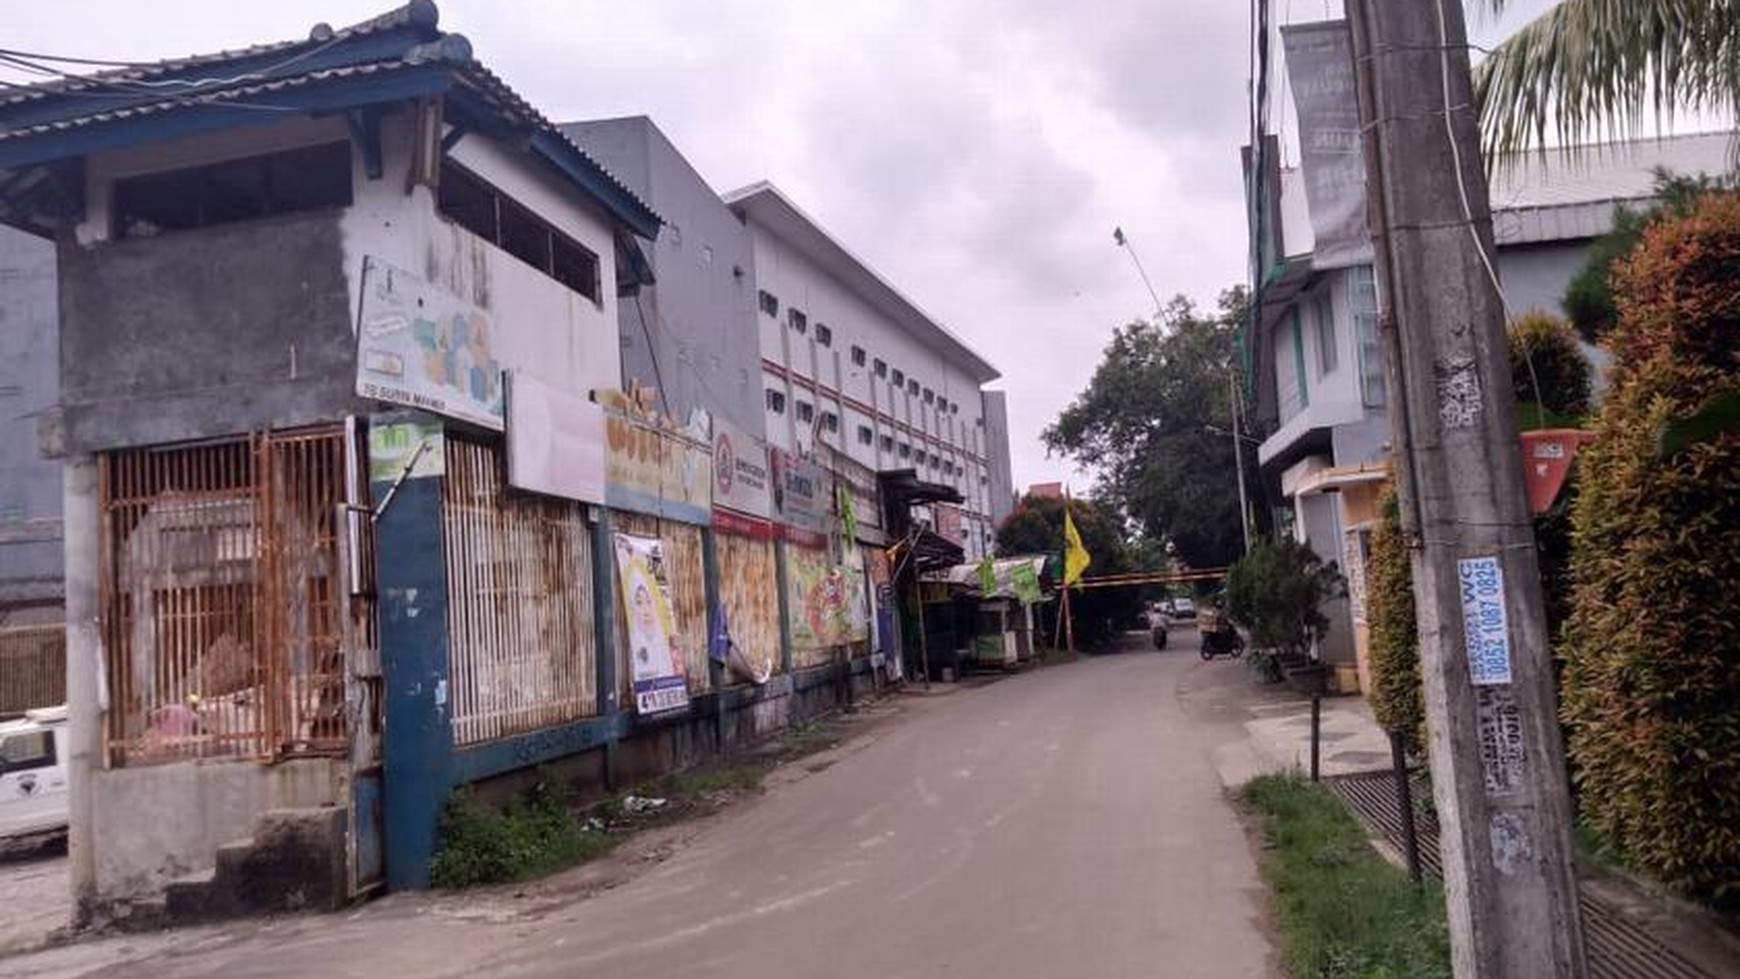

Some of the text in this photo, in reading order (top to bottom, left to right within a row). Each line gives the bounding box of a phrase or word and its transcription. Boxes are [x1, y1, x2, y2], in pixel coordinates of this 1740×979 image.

[1460, 562, 1476, 604] WC
[1474, 560, 1499, 596] 0825
[1478, 600, 1503, 633] 1087
[1484, 638, 1509, 675] 0852
